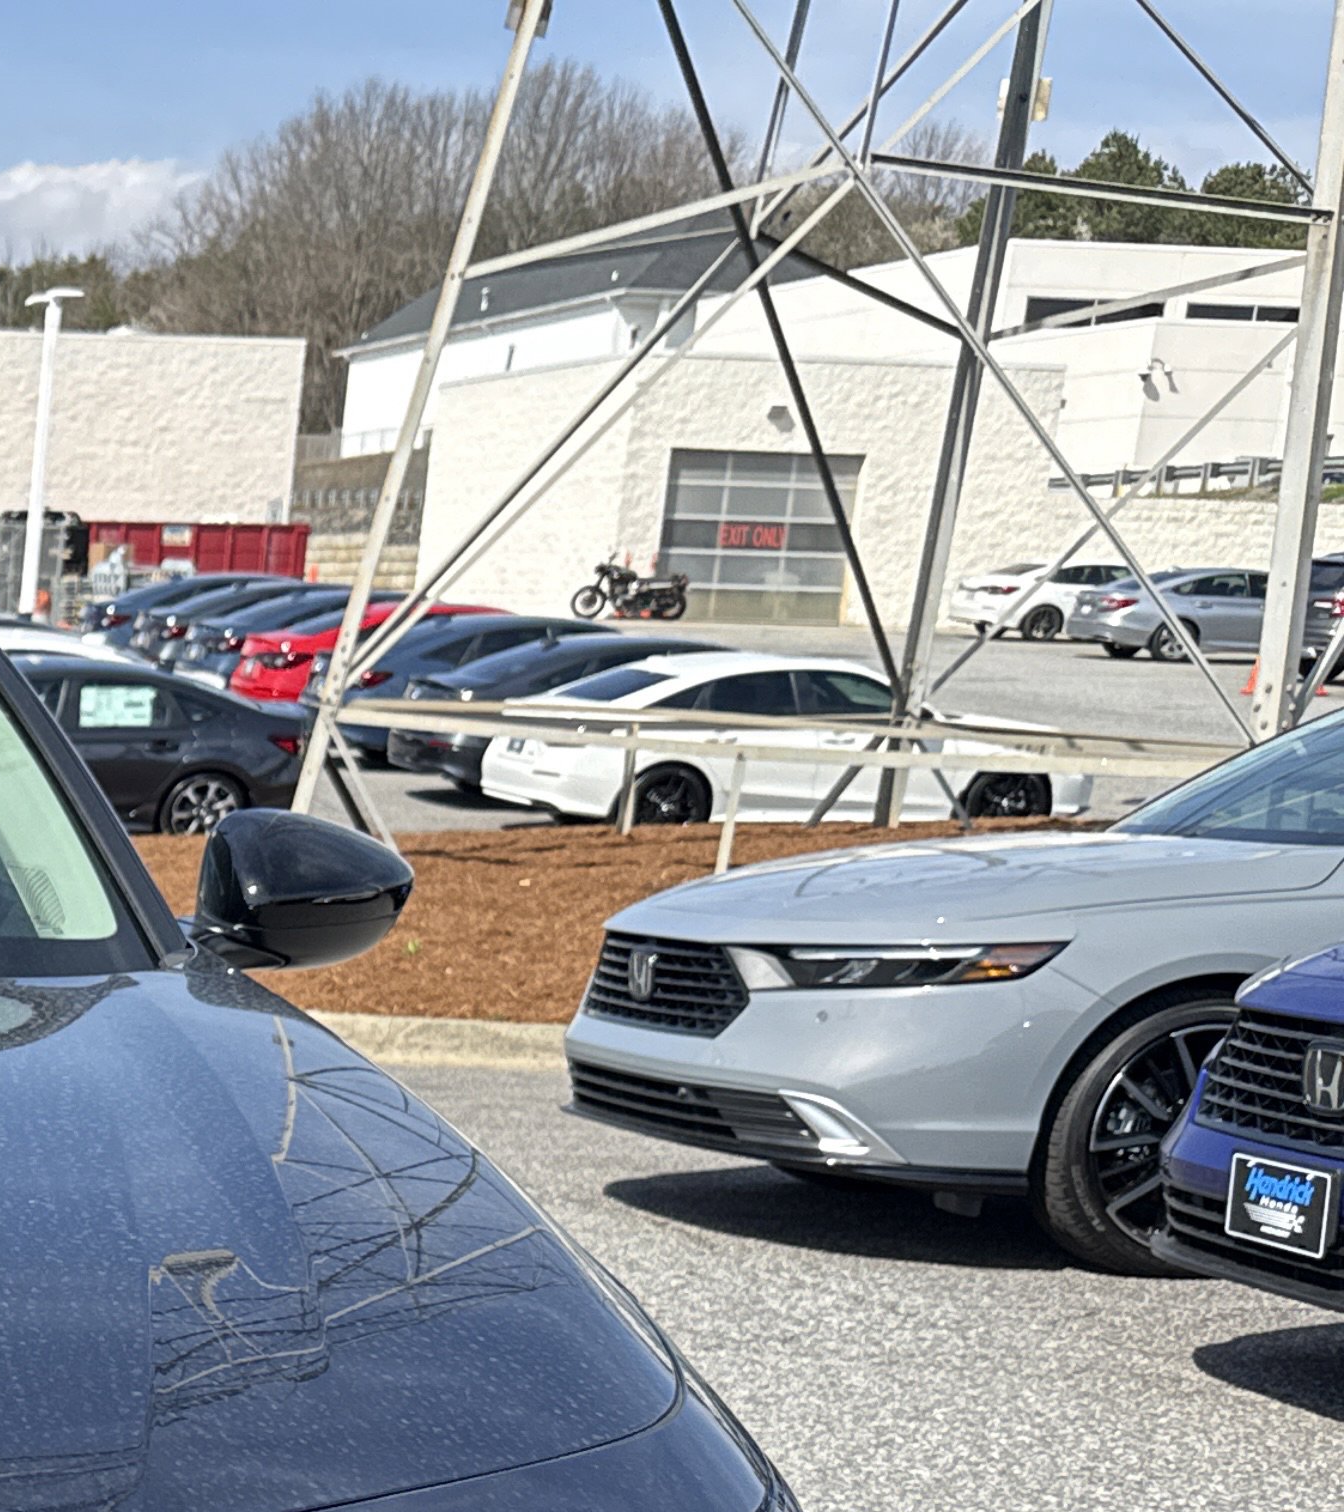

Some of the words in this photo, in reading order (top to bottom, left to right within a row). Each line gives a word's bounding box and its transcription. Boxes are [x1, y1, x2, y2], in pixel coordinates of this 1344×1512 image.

[720, 525, 749, 545] EXIT
[752, 525, 786, 547] ONLY
[1245, 1167, 1315, 1206] Hendrick
